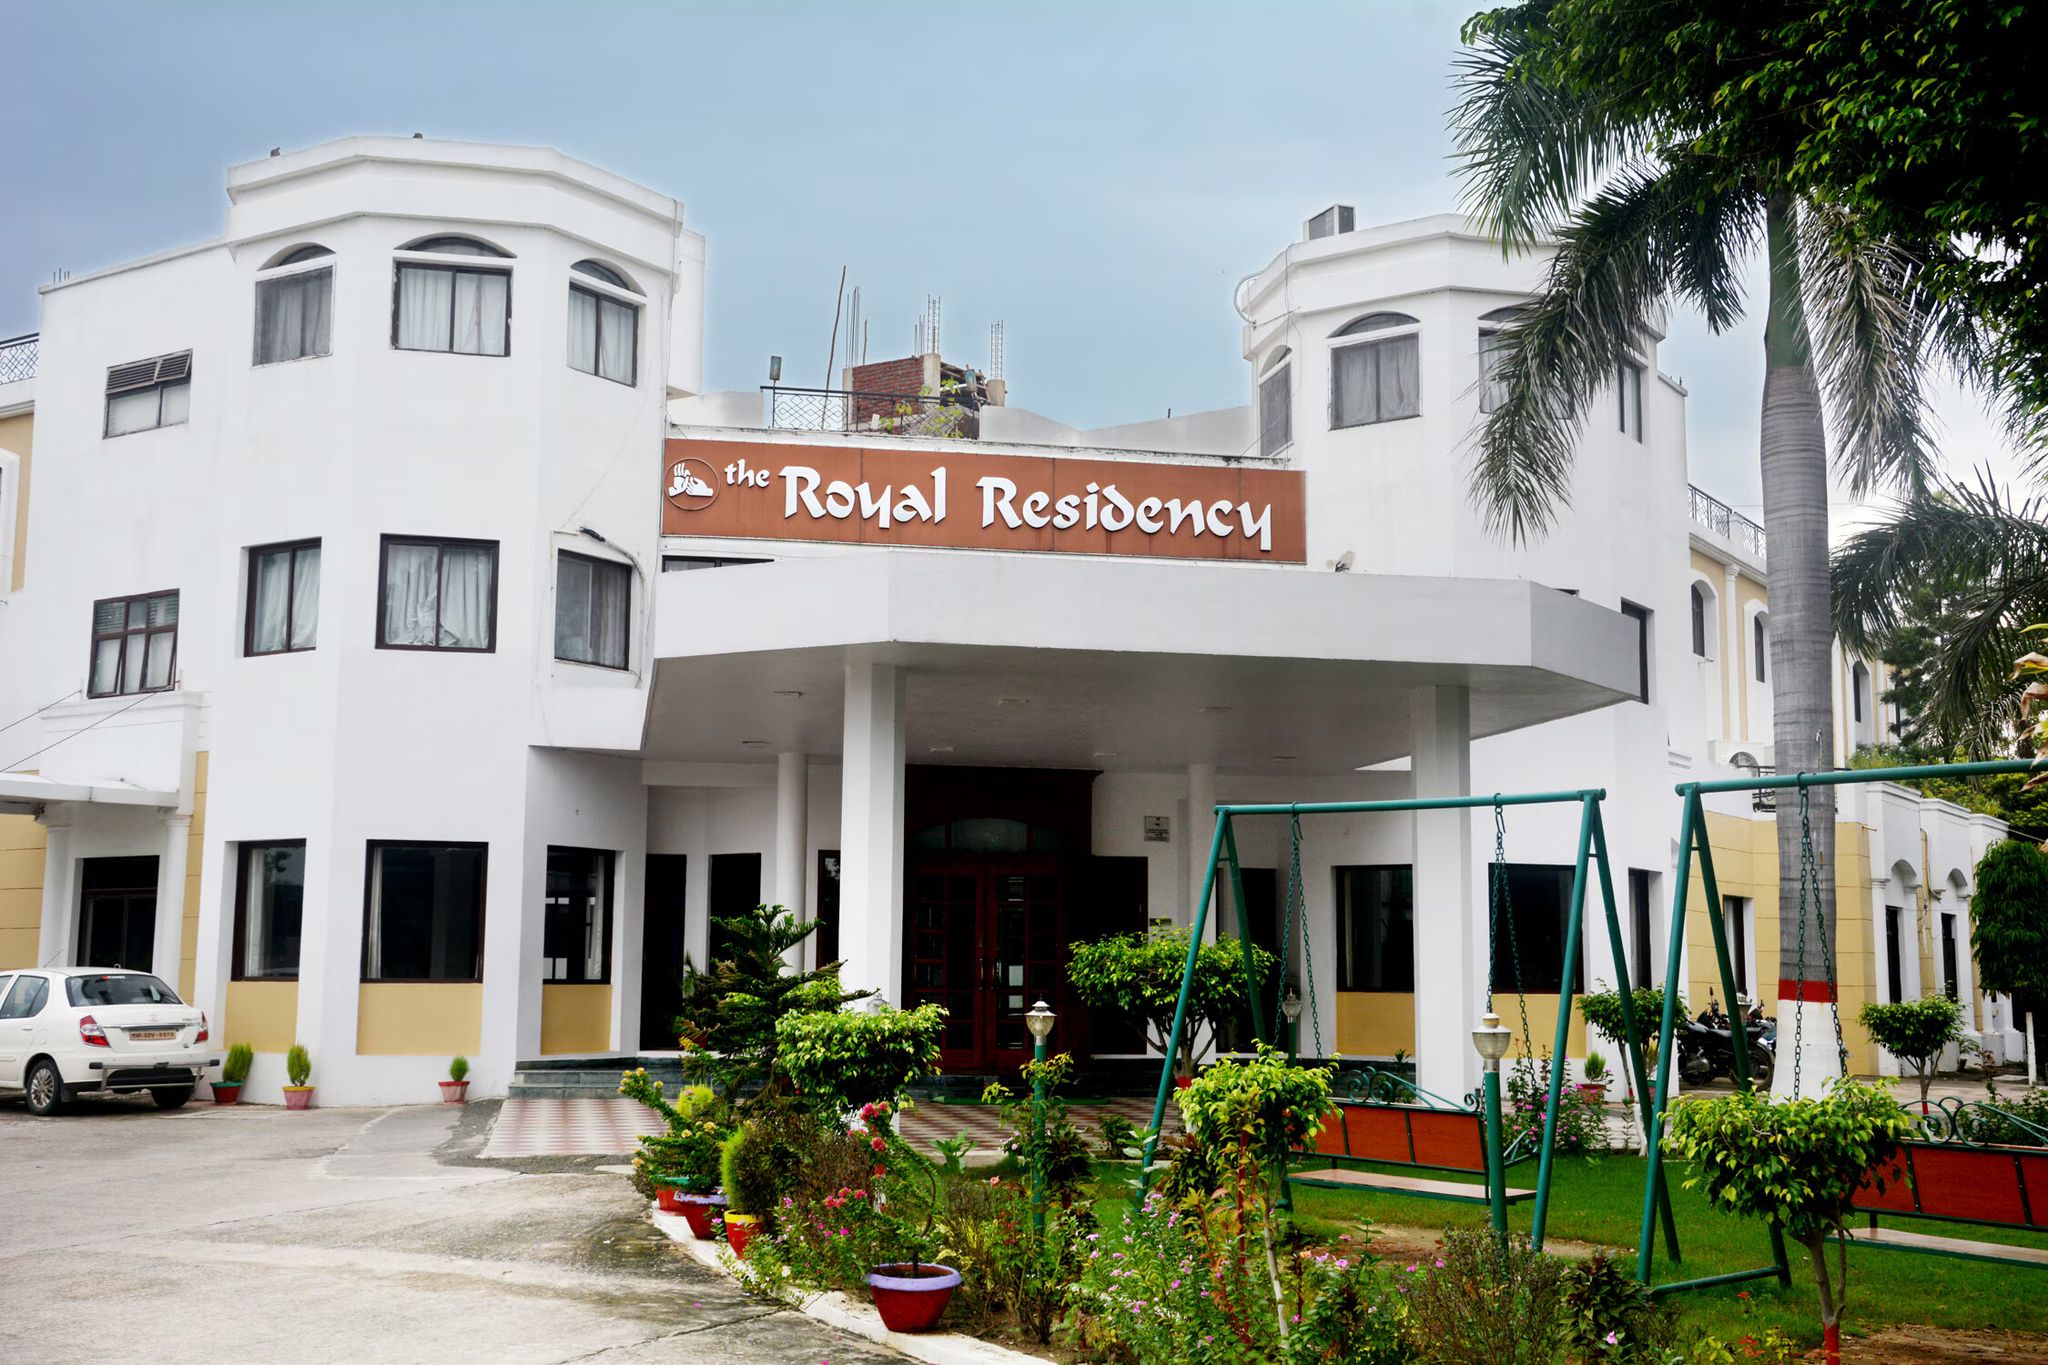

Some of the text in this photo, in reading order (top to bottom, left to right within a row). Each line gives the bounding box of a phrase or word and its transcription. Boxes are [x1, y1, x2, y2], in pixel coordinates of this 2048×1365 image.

[724, 458, 1272, 552] the Royal Residency
